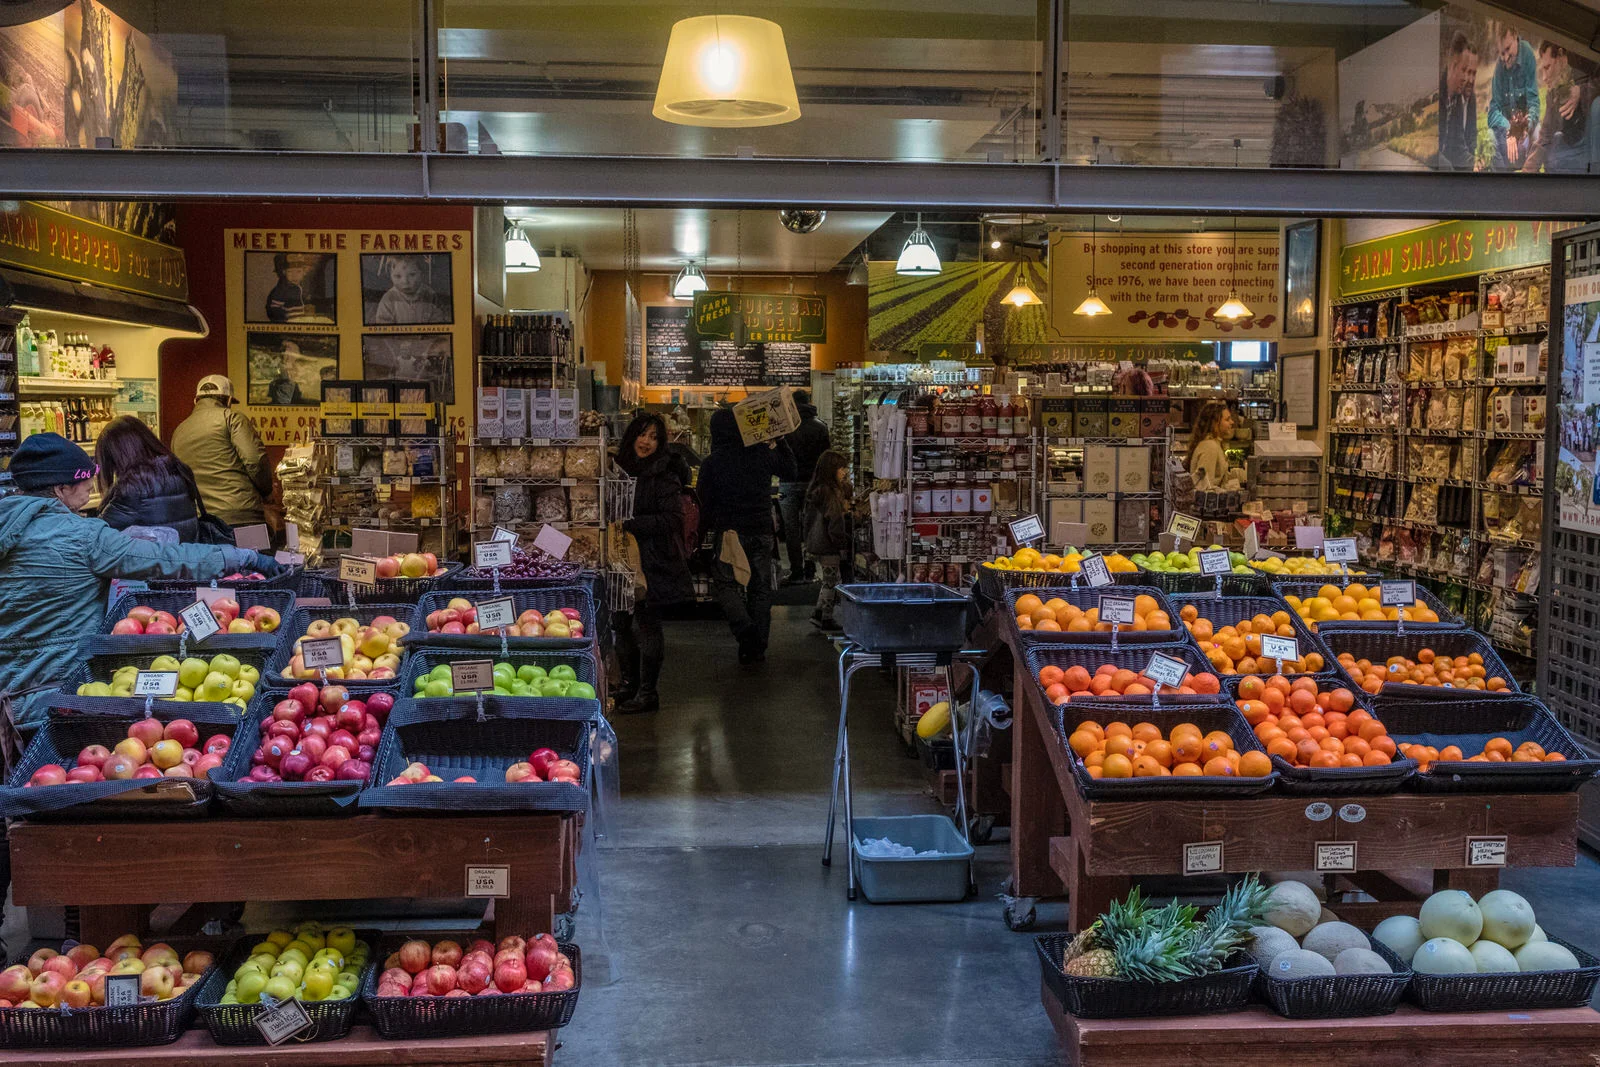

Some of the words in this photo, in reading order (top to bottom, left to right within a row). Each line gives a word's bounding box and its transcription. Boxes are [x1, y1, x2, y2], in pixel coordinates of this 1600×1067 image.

[49, 222, 121, 272] PREPPED
[233, 232, 292, 249] MEET
[304, 233, 347, 250] THE
[360, 233, 464, 250] FARMERS
[1084, 243, 1096, 256] By
[1100, 243, 1146, 256] shopping
[1150, 244, 1160, 254] at
[1164, 243, 1183, 255] this
[1186, 245, 1212, 255] store
[1216, 246, 1234, 256] you
[1238, 246, 1254, 255] are
[1352, 248, 1394, 282] FARM
[1401, 230, 1474, 272] SNACKS
[1484, 224, 1518, 255] FOR
[1120, 260, 1156, 270] second
[1159, 261, 1213, 272] generation
[1216, 262, 1253, 273] organic
[1086, 276, 1113, 286] Since
[1118, 276, 1144, 288] 1976,
[1148, 278, 1162, 286] we
[1166, 276, 1189, 286] have
[1192, 276, 1216, 286] been
[1220, 277, 1274, 288] connecting
[1110, 292, 1132, 302] with
[1136, 292, 1152, 302] the
[1156, 292, 1179, 302] farm
[1183, 292, 1203, 302] that
[1241, 293, 1264, 304] their
[702, 297, 728, 313] FARM
[700, 306, 730, 324] FRESH
[730, 332, 762, 341] OER
[768, 332, 792, 341] HERE
[1052, 349, 1116, 360] CHILLED
[347, 565, 367, 574] USA
[192, 612, 204, 625] USA
